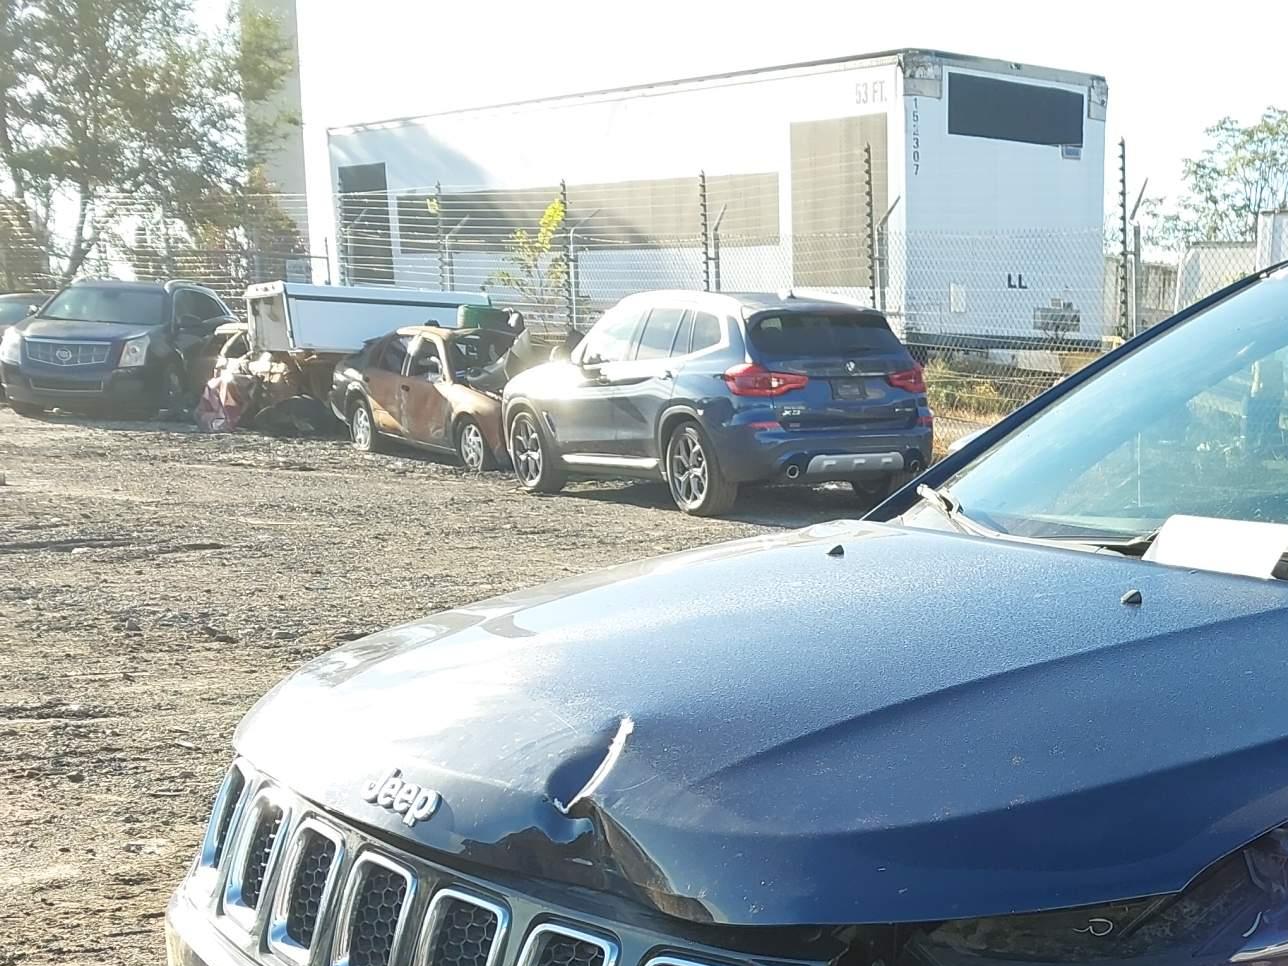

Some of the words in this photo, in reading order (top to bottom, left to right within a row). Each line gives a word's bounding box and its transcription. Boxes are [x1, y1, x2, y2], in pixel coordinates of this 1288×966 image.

[855, 82, 869, 104] 53
[1007, 274, 1028, 289] LL
[360, 767, 443, 828] Jeep
